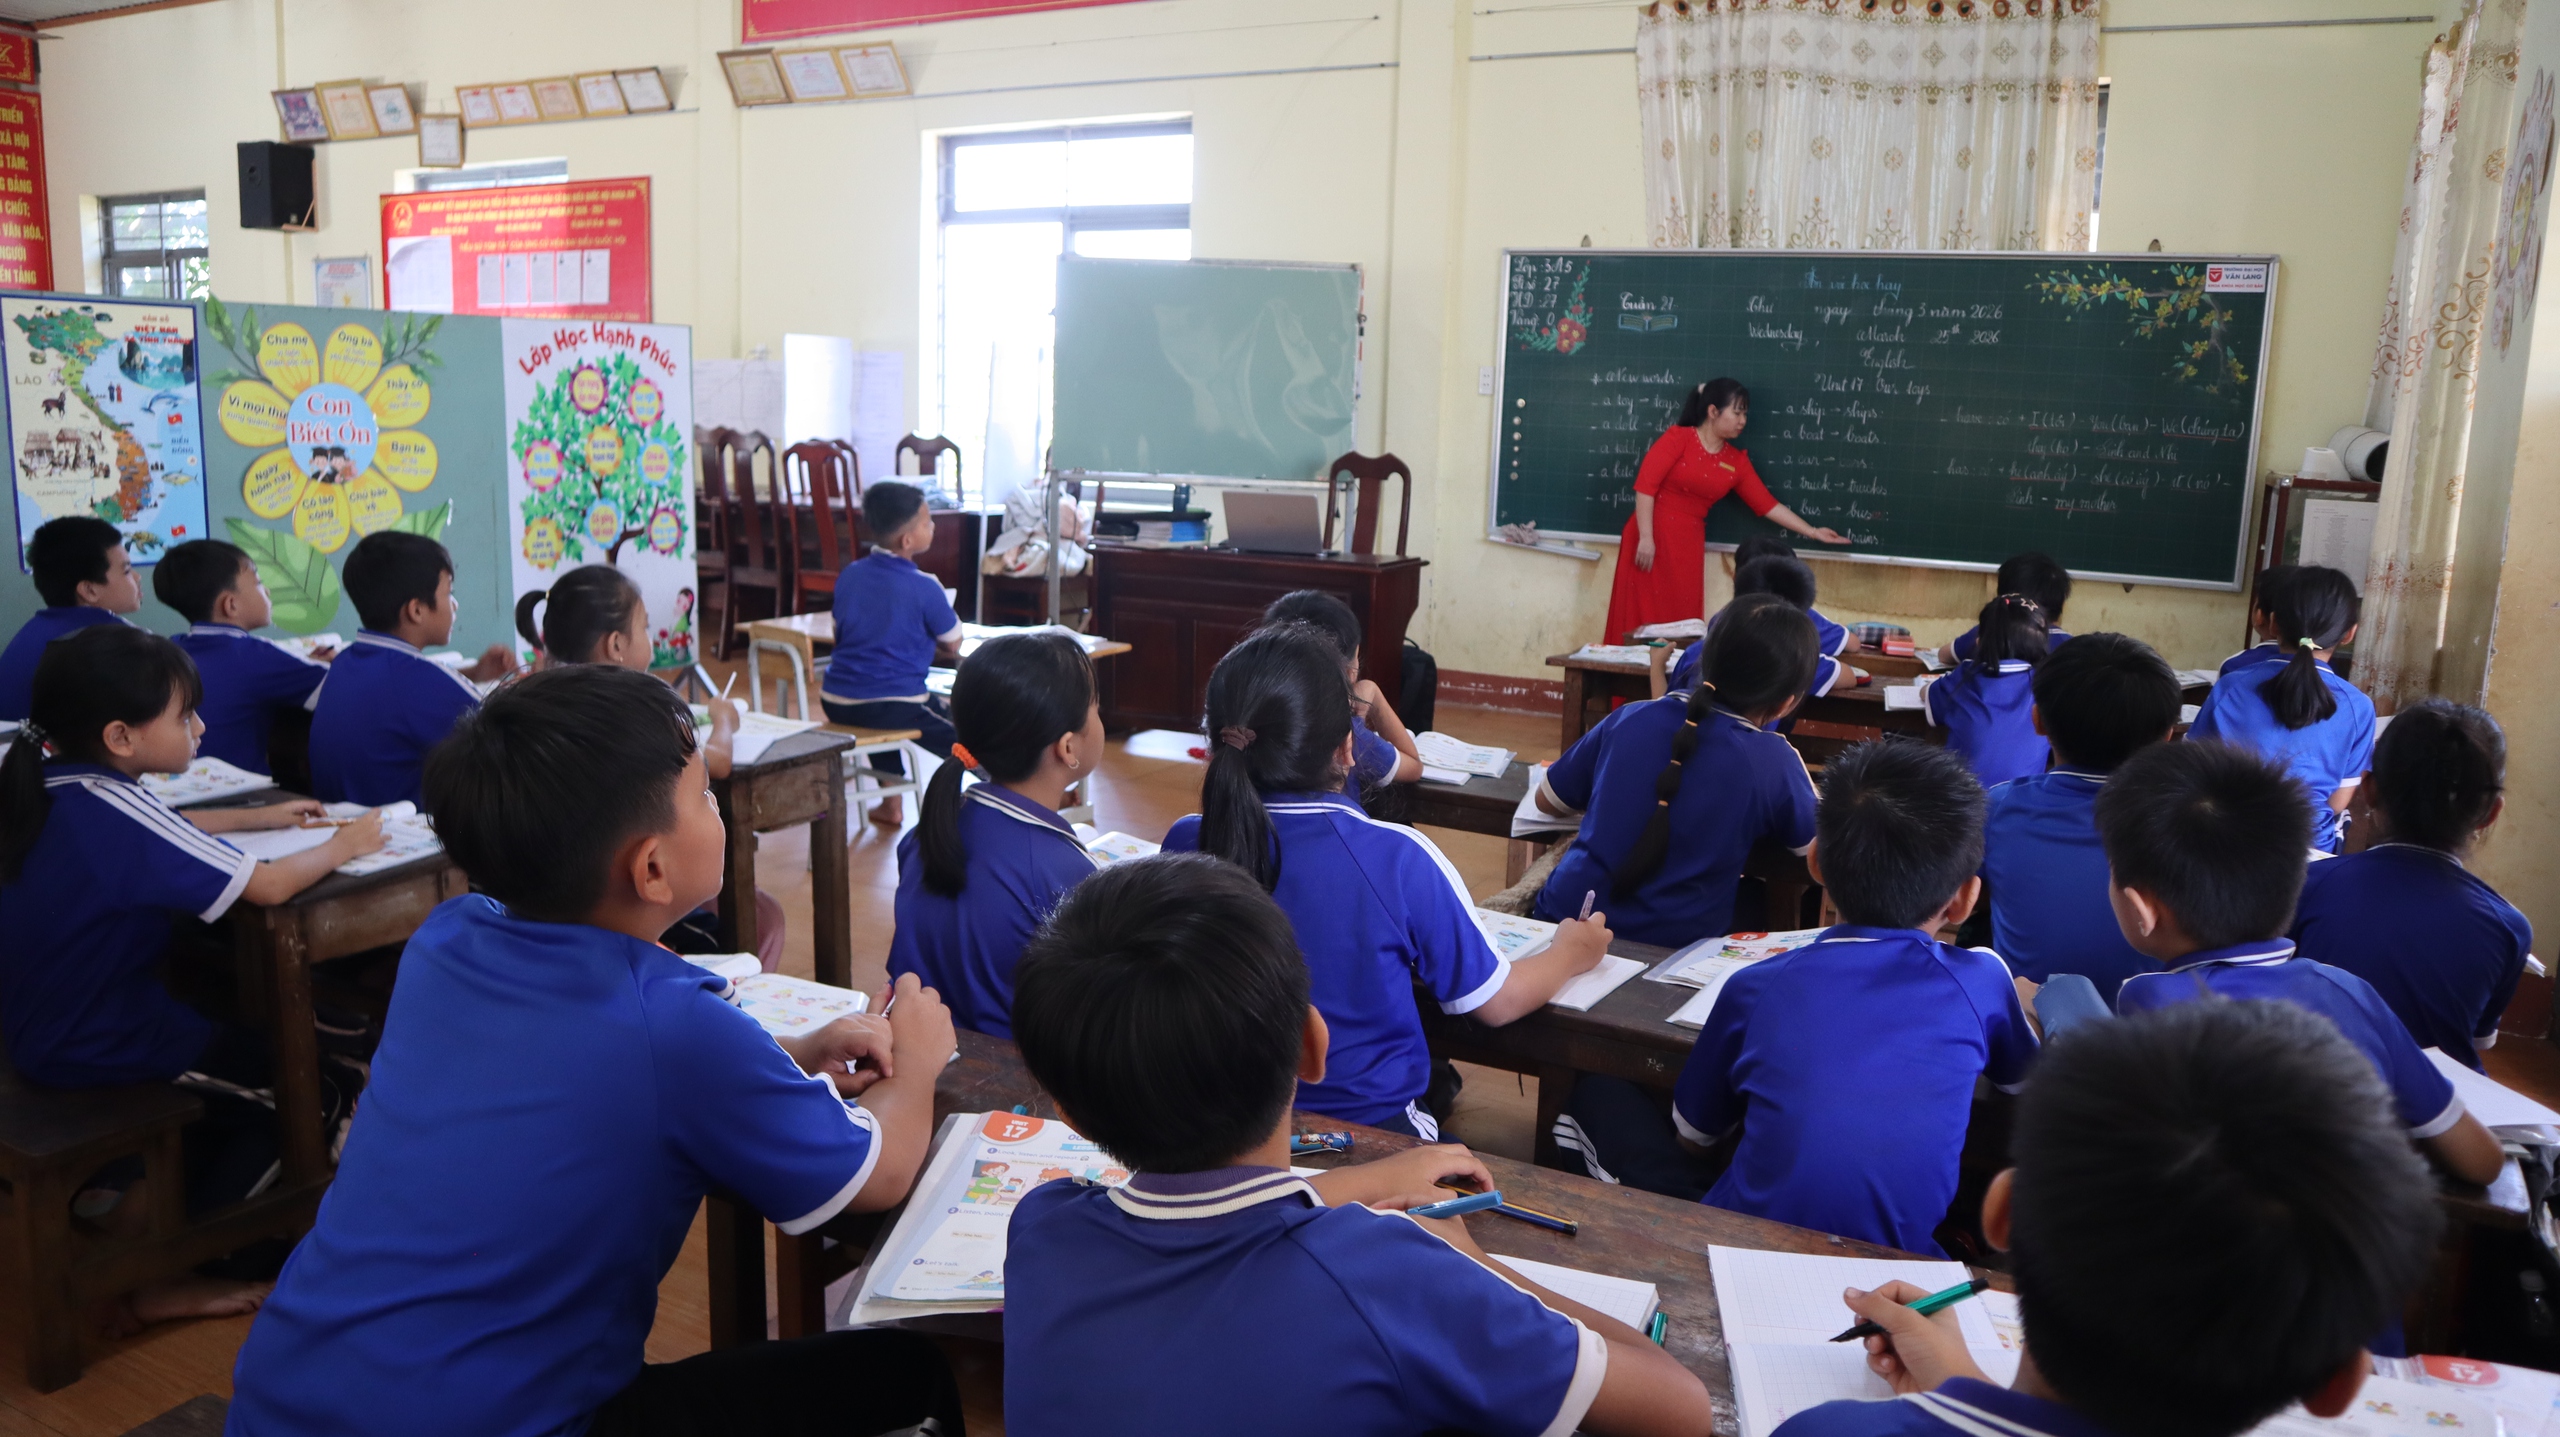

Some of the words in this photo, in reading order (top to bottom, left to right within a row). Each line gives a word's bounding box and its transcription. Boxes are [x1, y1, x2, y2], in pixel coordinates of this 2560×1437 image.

[1544, 276, 1560, 291] 27
[1917, 302, 1926, 317] 3
[1930, 305, 1966, 318] năm
[1970, 304, 2003, 319] 2026
[134, 325, 156, 333] VIỆT
[1856, 324, 1905, 342] March
[1969, 329, 2000, 345] 2026
[266, 334, 289, 346] Cha
[292, 335, 309, 347] mẹ
[338, 331, 358, 347] Ông
[518, 344, 552, 375] Lớp
[554, 328, 588, 352] Học
[592, 321, 635, 349] Hạnh
[639, 335, 677, 376] Phúc
[1859, 346, 1916, 378] English
[15, 372, 42, 385] LÀO
[1814, 372, 1848, 392] Unit
[1850, 377, 1864, 392] 17
[1906, 380, 1931, 405] toys
[243, 401, 265, 415] mọi
[306, 392, 352, 416] Con
[1604, 397, 1611, 406] a
[1617, 394, 1634, 415] toy
[1654, 395, 1680, 418] toys
[1786, 405, 1794, 415] a
[1800, 398, 1826, 426] ship
[1603, 420, 1610, 430] a
[1615, 415, 1640, 431] doll
[290, 419, 334, 444] Biết
[338, 419, 372, 444] Ơn
[1783, 429, 1792, 439] a
[1799, 423, 1824, 440] boat
[391, 441, 411, 453] Bạn
[1600, 444, 1609, 454] a
[2128, 444, 2150, 459] and
[1783, 455, 1793, 465] a
[1798, 455, 1820, 466] car
[1600, 468, 1608, 478] a
[1783, 480, 1792, 490] a
[1800, 473, 1832, 492] truck
[1600, 492, 1609, 501] a
[1800, 498, 1821, 516] bus
[2055, 498, 2076, 519] my
[1780, 529, 1788, 538] a
[1002, 1125, 1028, 1139] 17
